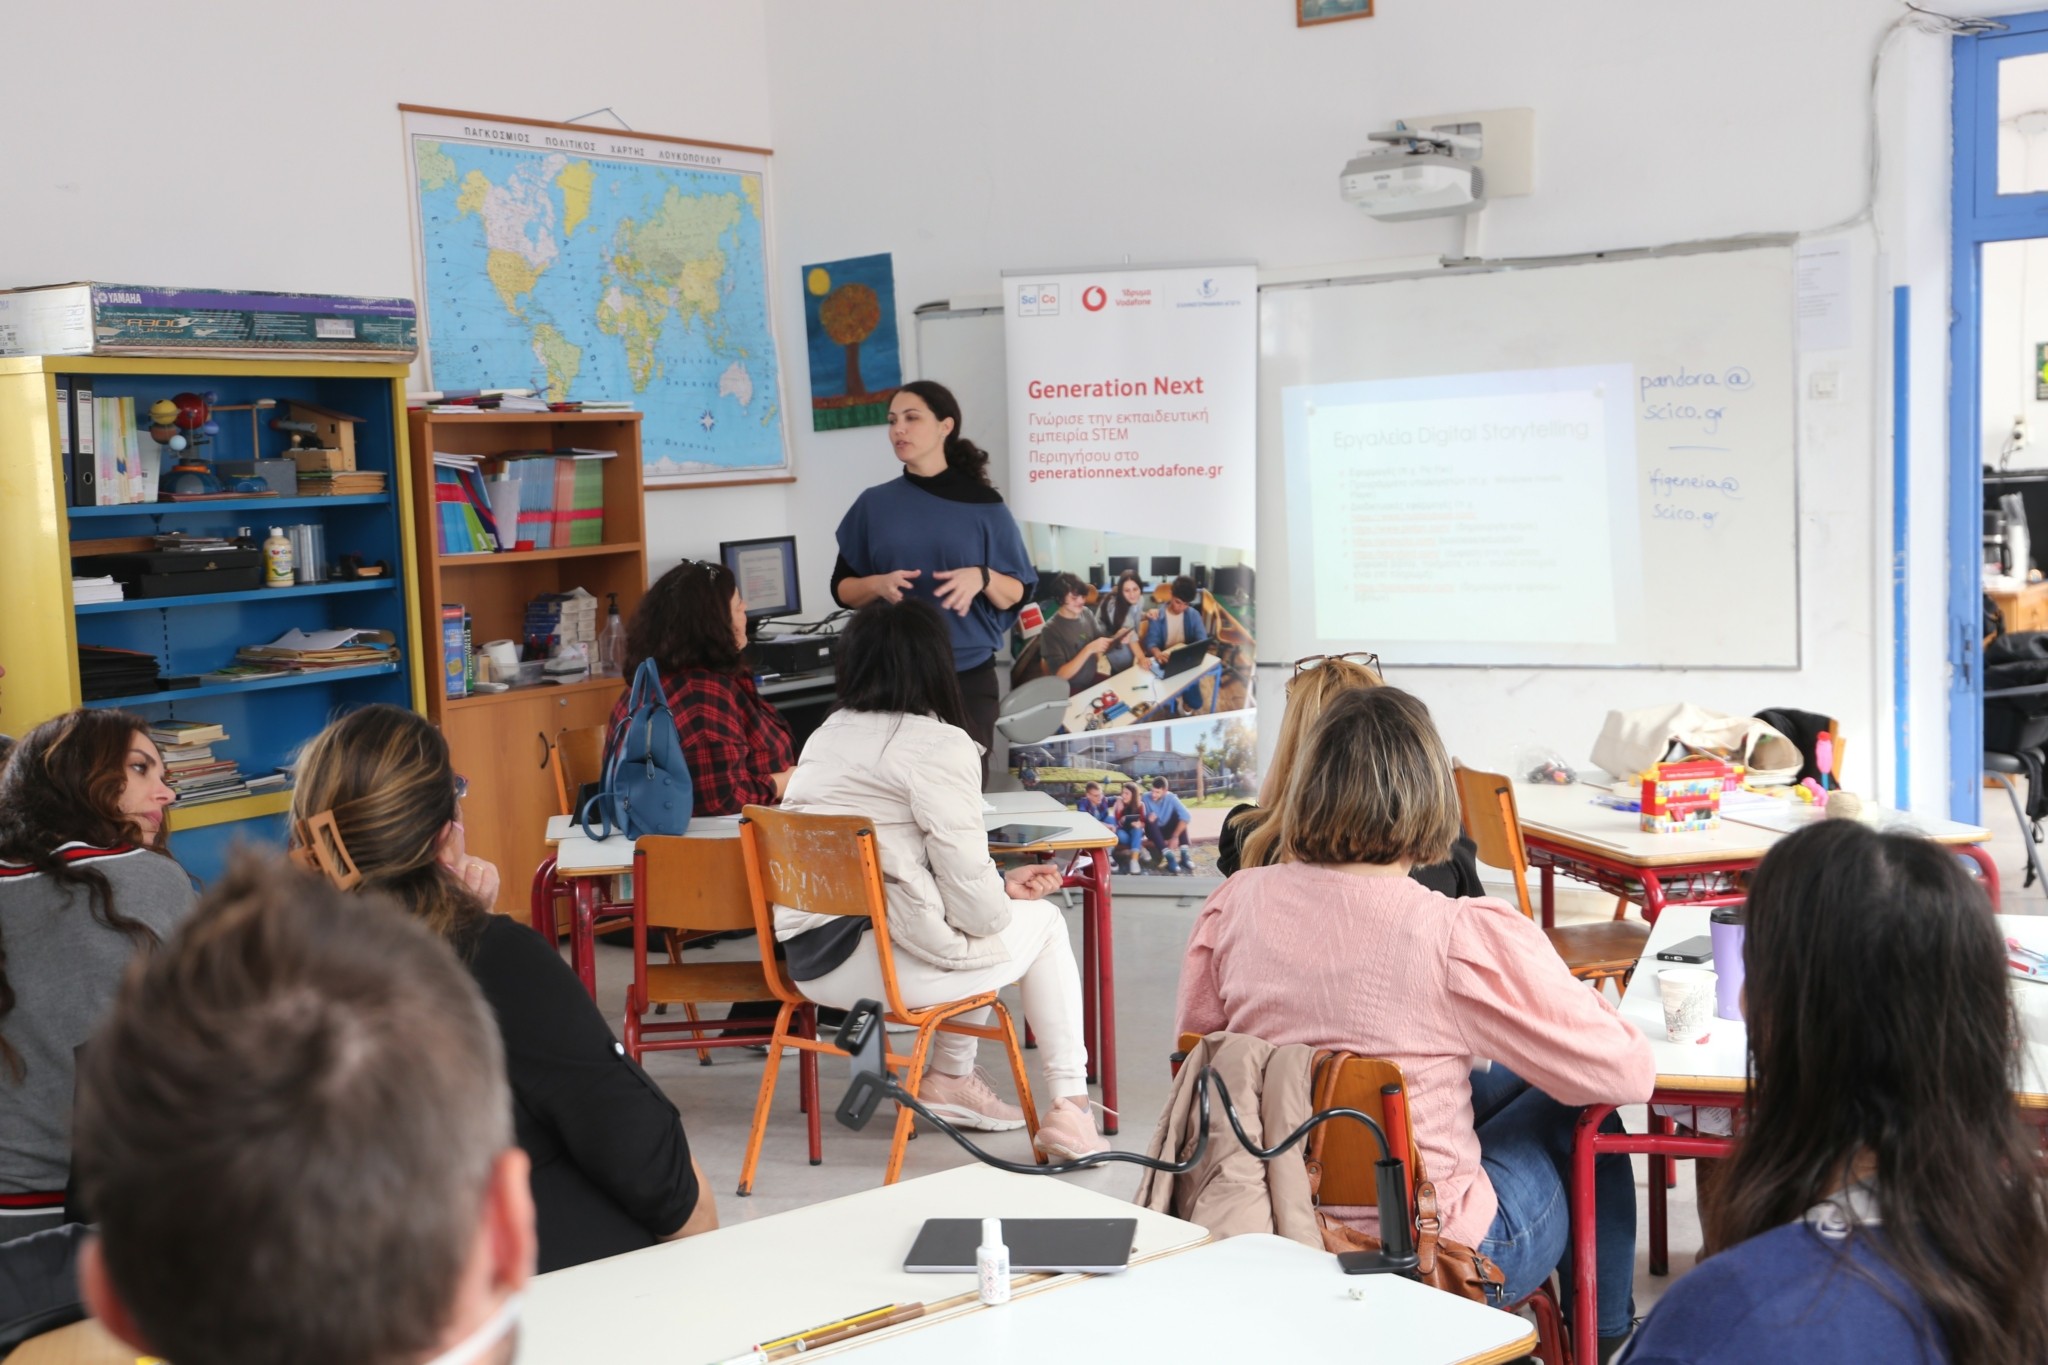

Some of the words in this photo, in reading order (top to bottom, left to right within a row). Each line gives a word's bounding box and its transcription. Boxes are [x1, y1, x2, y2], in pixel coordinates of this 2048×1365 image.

[464, 126, 530, 143] ΠΑΓΚΟΣΜΙΟΣ
[545, 136, 596, 151] ΠΟΛΙΤΙΚΟΣ
[610, 145, 645, 157] ΧΑΡΤΗΣ
[658, 150, 722, 165] ΛΟΥΚΟΠΟΥΛΟΥ
[107, 293, 142, 304] YAMAHA
[1021, 294, 1037, 305] Sci
[1041, 294, 1056, 305] Co
[1115, 298, 1152, 307] Vodafone
[1028, 379, 1147, 399] Generation
[1154, 376, 1204, 395] Next
[1029, 412, 1084, 427] Γνώρισε
[1088, 414, 1112, 427] την
[1116, 408, 1209, 425] εκπαιδευτική
[1029, 429, 1088, 444] εμπειρία
[1092, 428, 1129, 441] STEM
[1418, 423, 1477, 447] Digital
[1482, 419, 1590, 444] Storytelling
[1029, 450, 1111, 465] Περιηγήσου
[1114, 451, 1140, 462] στο
[1029, 464, 1224, 483] generationnext.vodafone.gr
